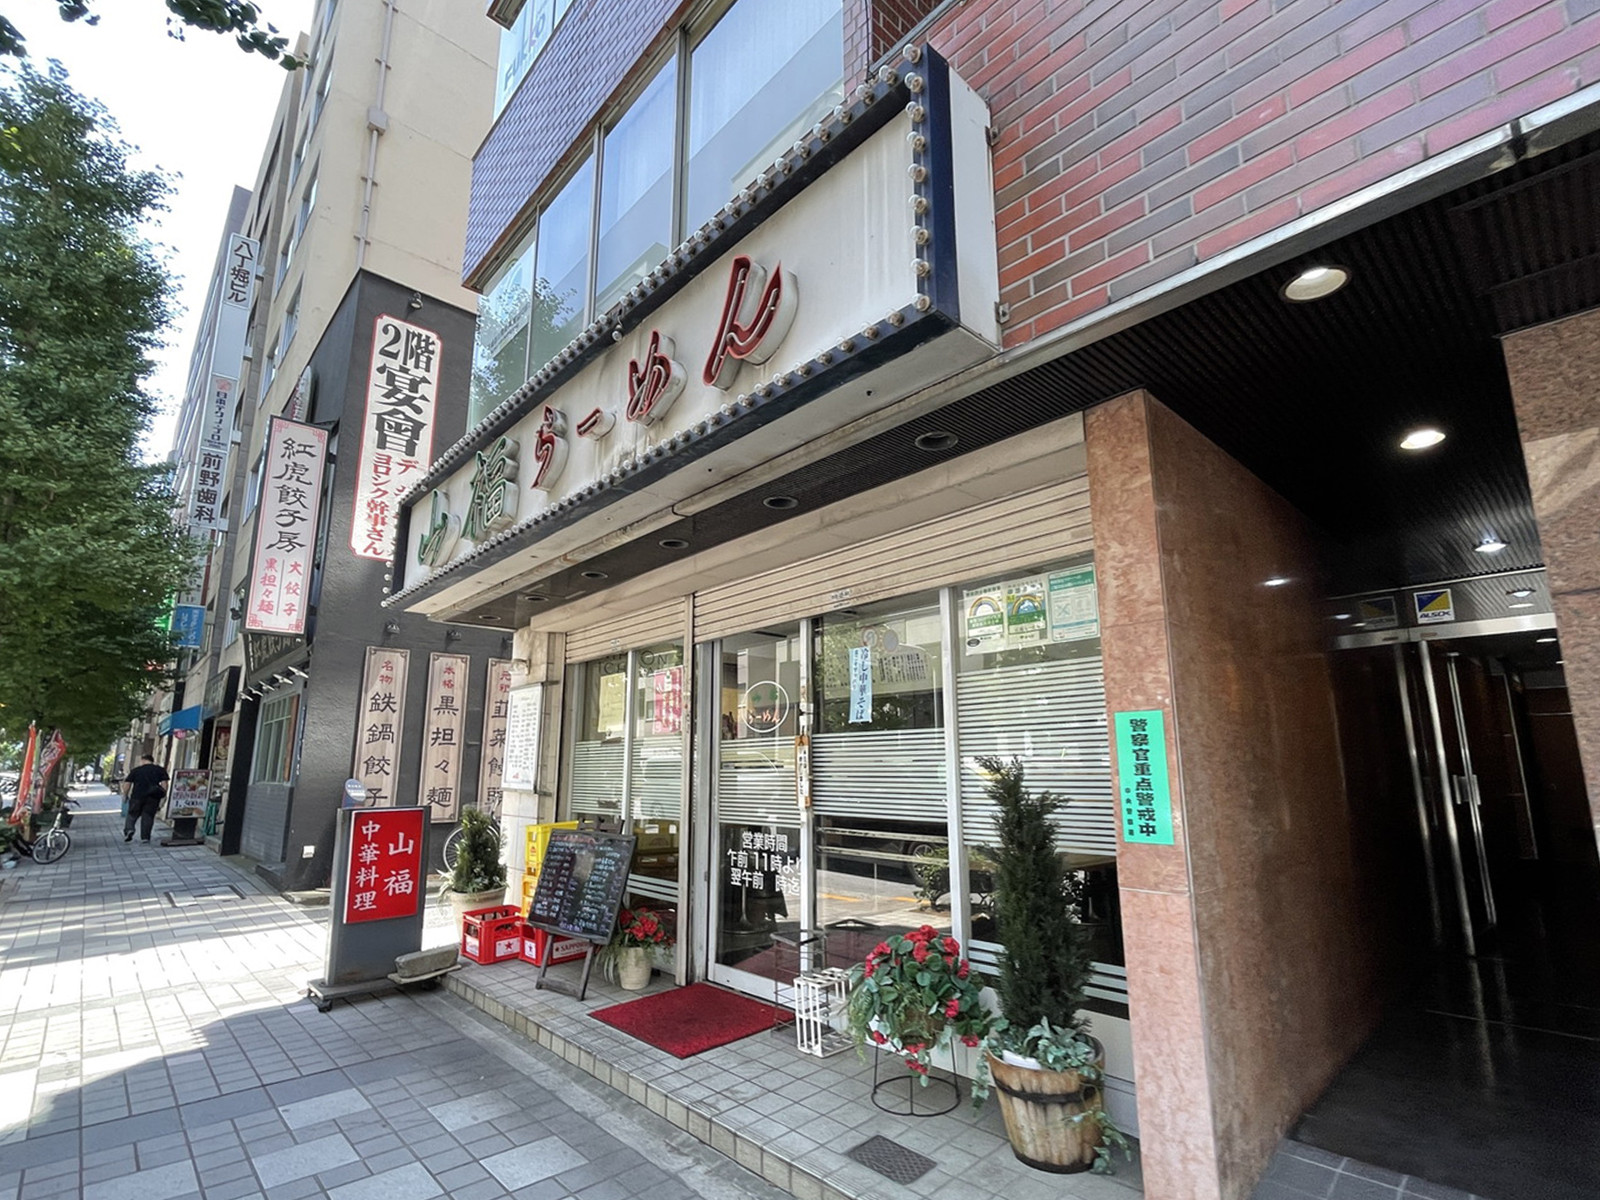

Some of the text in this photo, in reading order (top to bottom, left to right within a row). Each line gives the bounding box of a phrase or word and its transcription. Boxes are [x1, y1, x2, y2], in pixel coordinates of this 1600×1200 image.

[227, 240, 253, 303] 八丁堀ビル
[193, 452, 223, 524] 前野歯科
[265, 436, 318, 553] 紅虎餃子房
[257, 557, 278, 616] 黒担々麺
[283, 561, 303, 616] 大餃子
[1419, 610, 1452, 618] ALSOK
[379, 660, 394, 685] 名物
[442, 666, 455, 689] 本格
[363, 692, 397, 807] 鉄鍋餃子
[427, 695, 459, 808] 黒担々麺
[1129, 718, 1157, 837] 警察官重点警戒中
[353, 820, 381, 911] 中華料理
[383, 832, 414, 896] 山福
[742, 830, 788, 853] 営業時間
